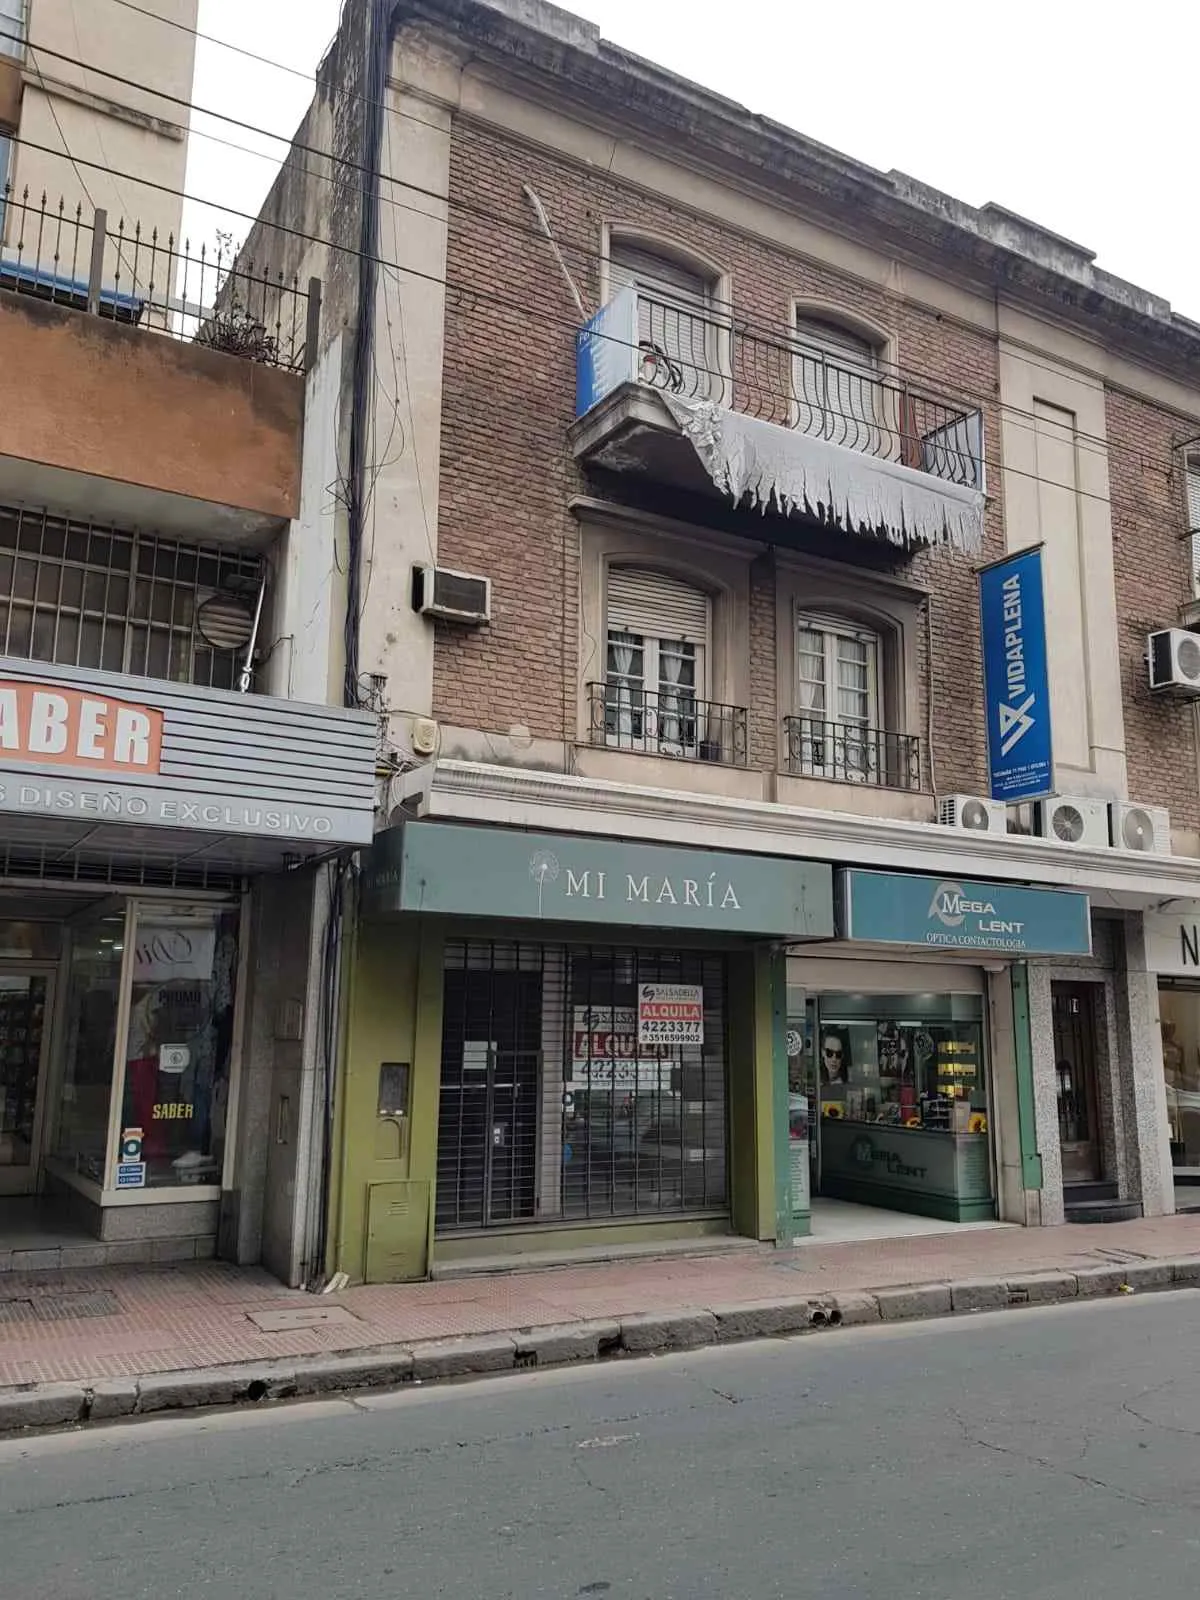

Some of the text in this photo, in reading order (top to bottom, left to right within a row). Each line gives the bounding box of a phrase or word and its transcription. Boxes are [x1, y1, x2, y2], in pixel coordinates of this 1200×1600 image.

[1003, 573, 1025, 700] VIDAPLENA
[19, 785, 147, 816] DISEÑO
[160, 801, 333, 833] EXCLUSIVO
[565, 870, 741, 909] MI MARÍA
[942, 893, 996, 915] MEGA
[978, 919, 1025, 934] LENT
[642, 1004, 700, 1018] ALQUILA
[642, 1020, 701, 1033] 4223377
[152, 1103, 194, 1120] SABER
